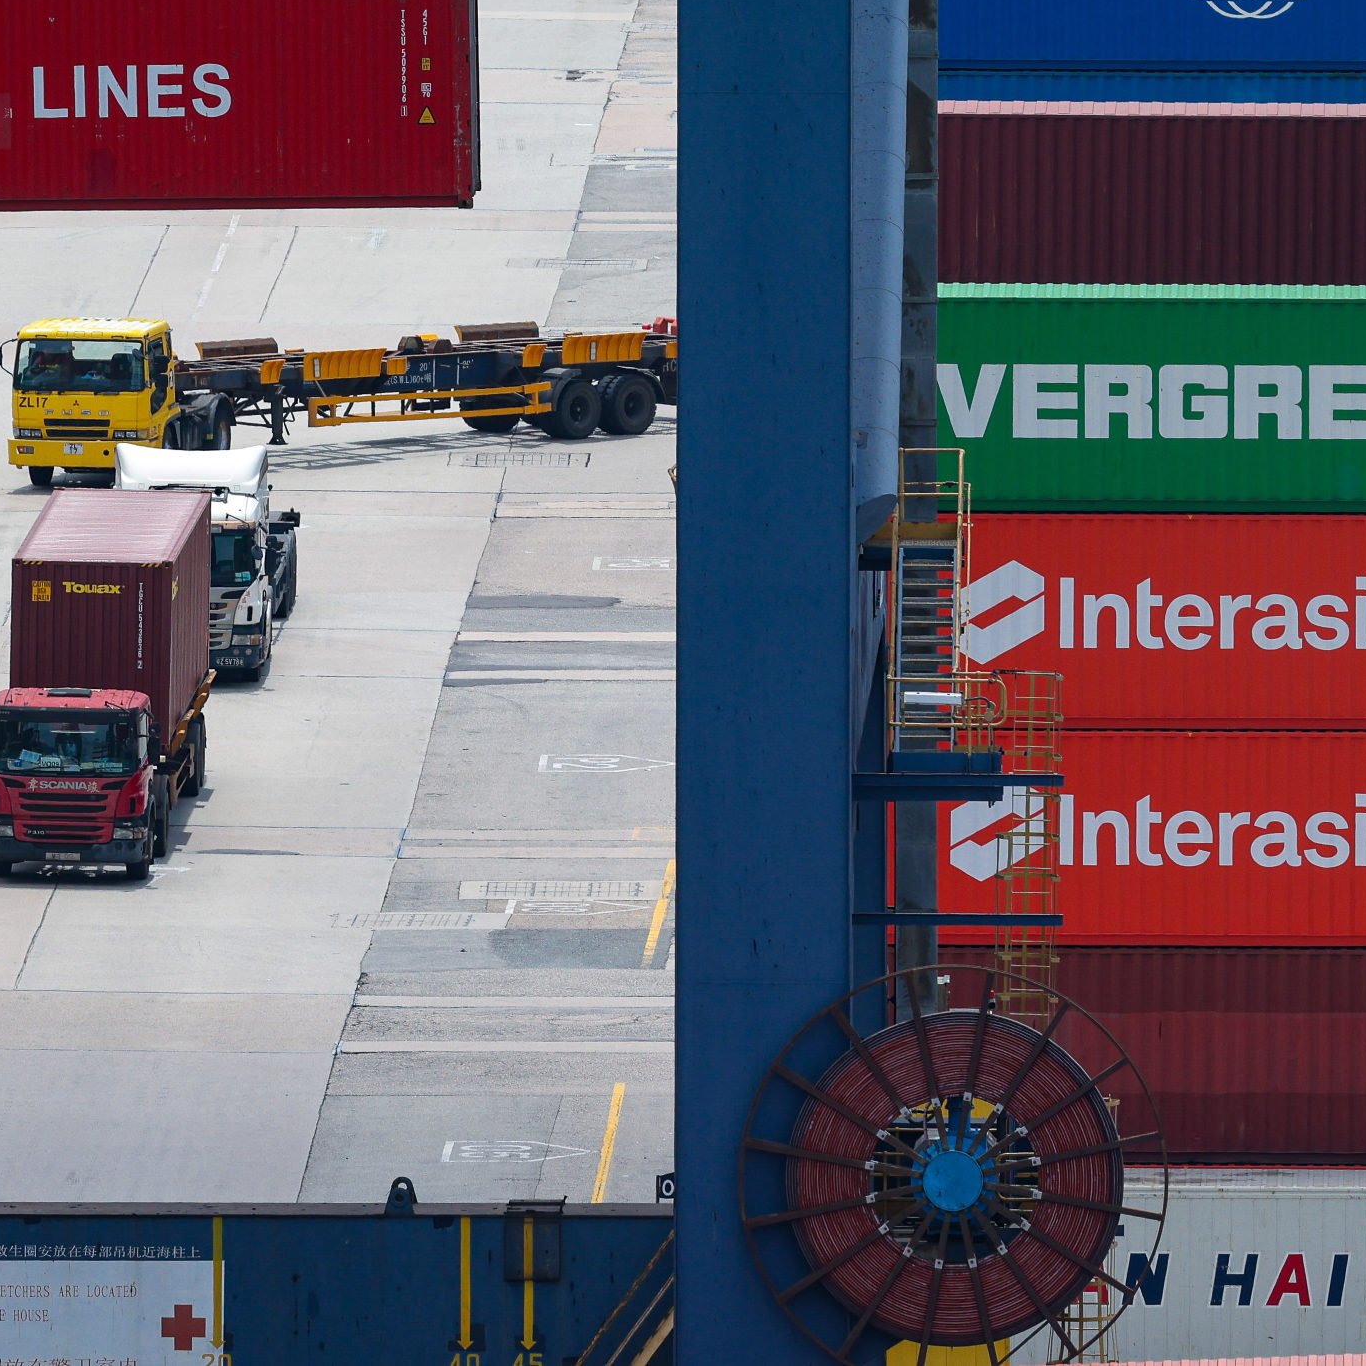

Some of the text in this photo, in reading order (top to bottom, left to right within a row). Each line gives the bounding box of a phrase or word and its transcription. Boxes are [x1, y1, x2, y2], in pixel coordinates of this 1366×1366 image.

[32, 62, 233, 120] LINES
[18, 396, 49, 410] ZL17
[43, 408, 110, 418] FUSO
[39, 779, 88, 791] SCANIA
[1208, 1251, 1351, 1309] HAI
[58, 1284, 80, 1299] ARE
[87, 1284, 138, 1299] LOCATED
[13, 1308, 50, 1323] HOUSE
